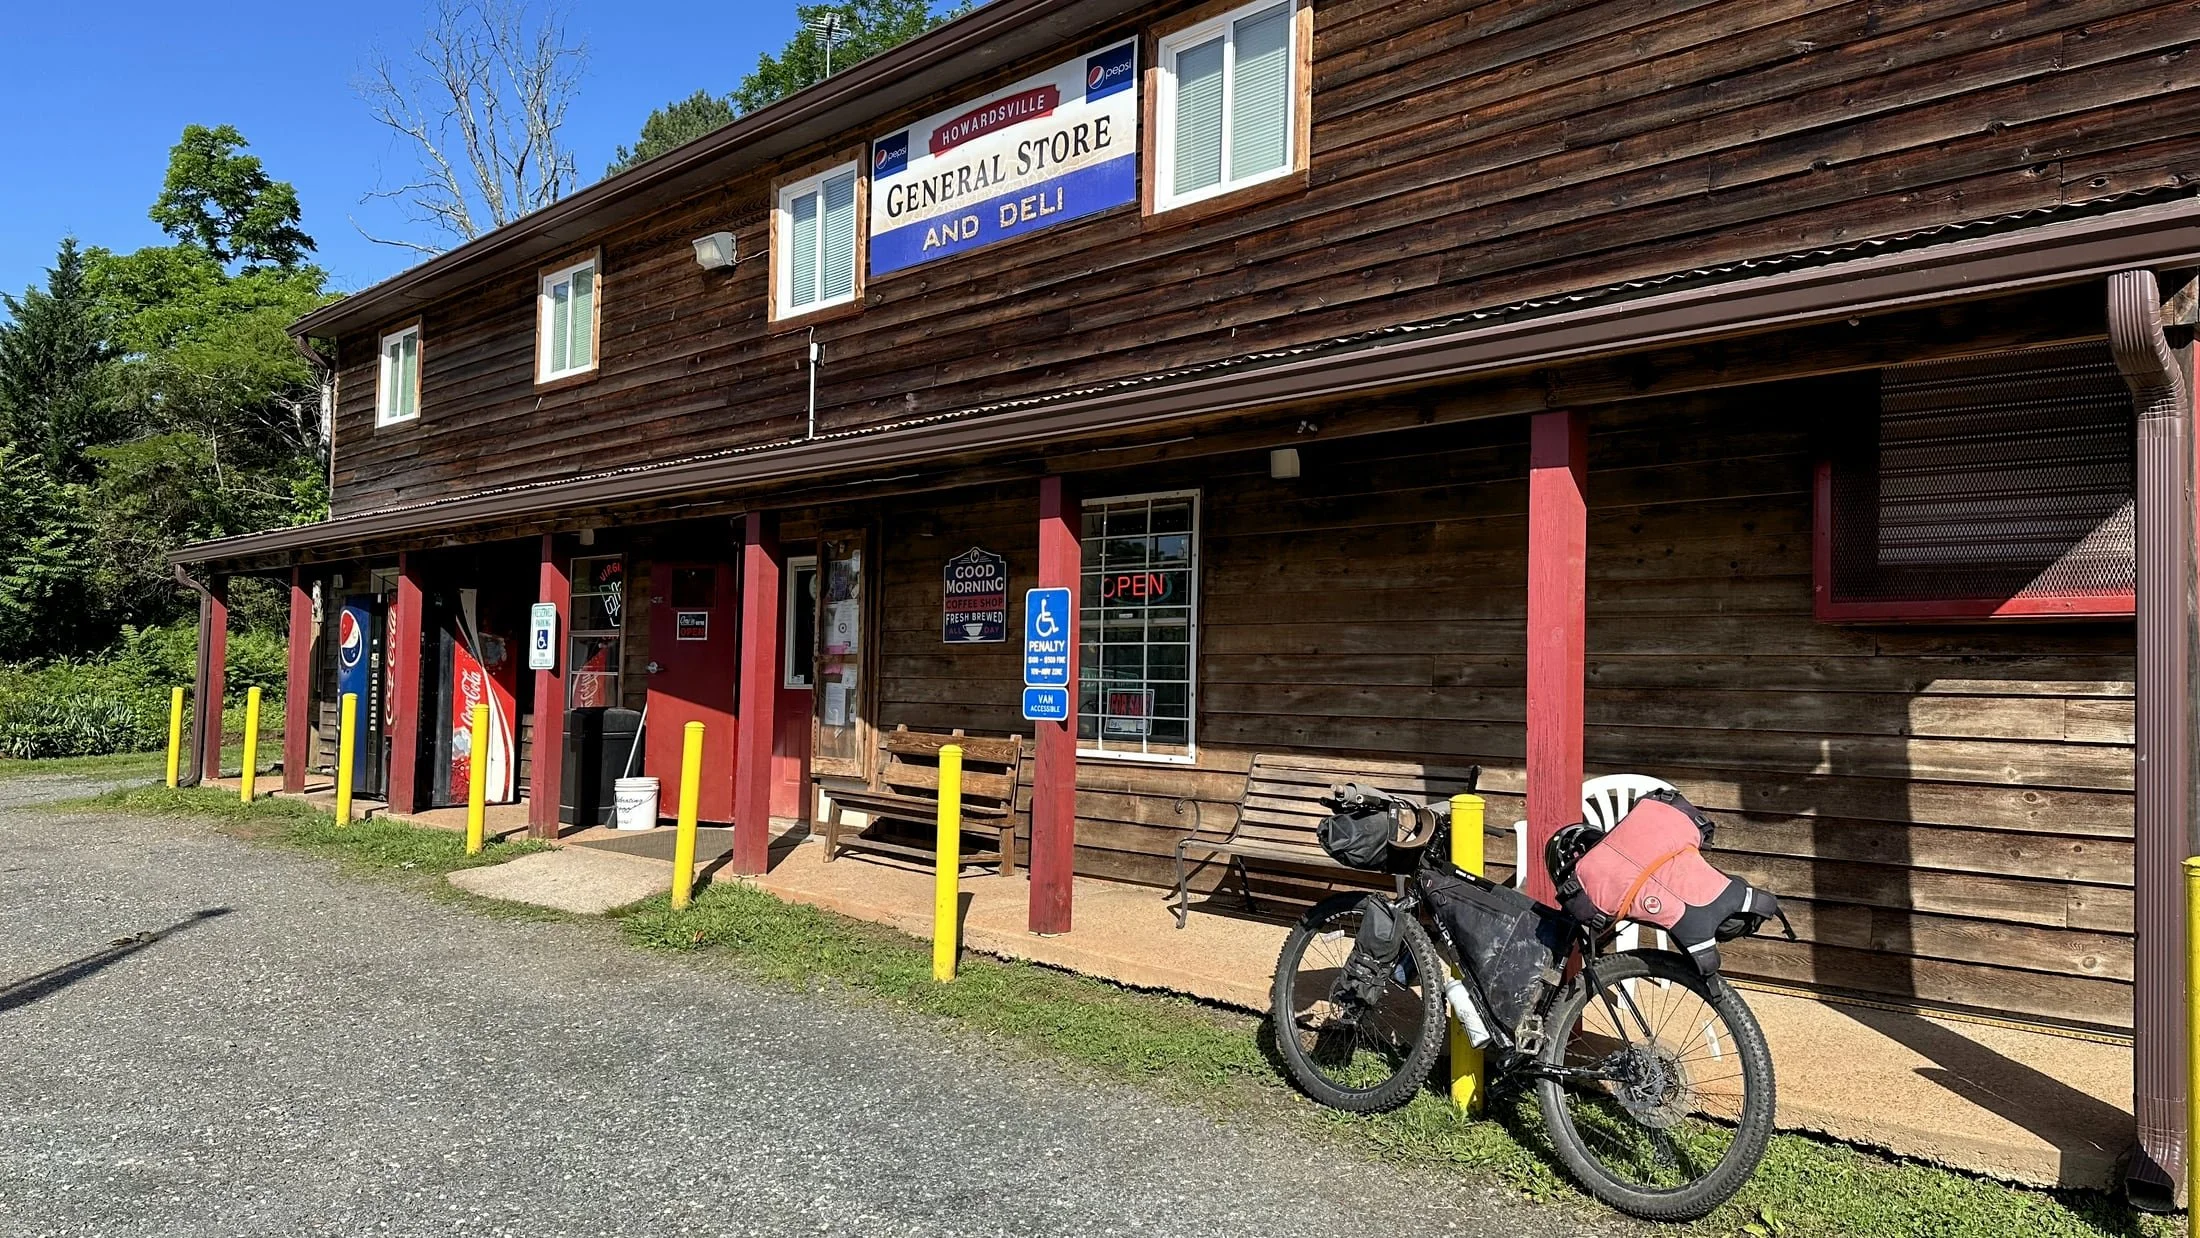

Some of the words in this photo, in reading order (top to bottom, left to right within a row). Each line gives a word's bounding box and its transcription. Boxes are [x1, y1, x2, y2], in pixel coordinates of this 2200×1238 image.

[1105, 58, 1132, 80] pepsi
[942, 94, 1045, 146] HOWARDSVILLE
[887, 145, 907, 161] pepsi
[886, 154, 1006, 218] GENERAL
[1017, 115, 1112, 176] STORE
[923, 215, 979, 251] AND
[999, 187, 1064, 229] DELI
[600, 562, 622, 582] VIRGI
[955, 564, 995, 579] GOOD
[946, 577, 1004, 594] MORNING
[1101, 573, 1164, 598] OPEN
[946, 599, 979, 610] COFFEE
[980, 597, 1004, 608] SHOP
[946, 612, 970, 626] FRESH
[971, 611, 1003, 624] BREWED
[983, 626, 1000, 634] DAY
[1028, 640, 1065, 653] PENALTY
[1037, 694, 1054, 705] VAN
[1030, 704, 1061, 713] ACCESSIBLE
